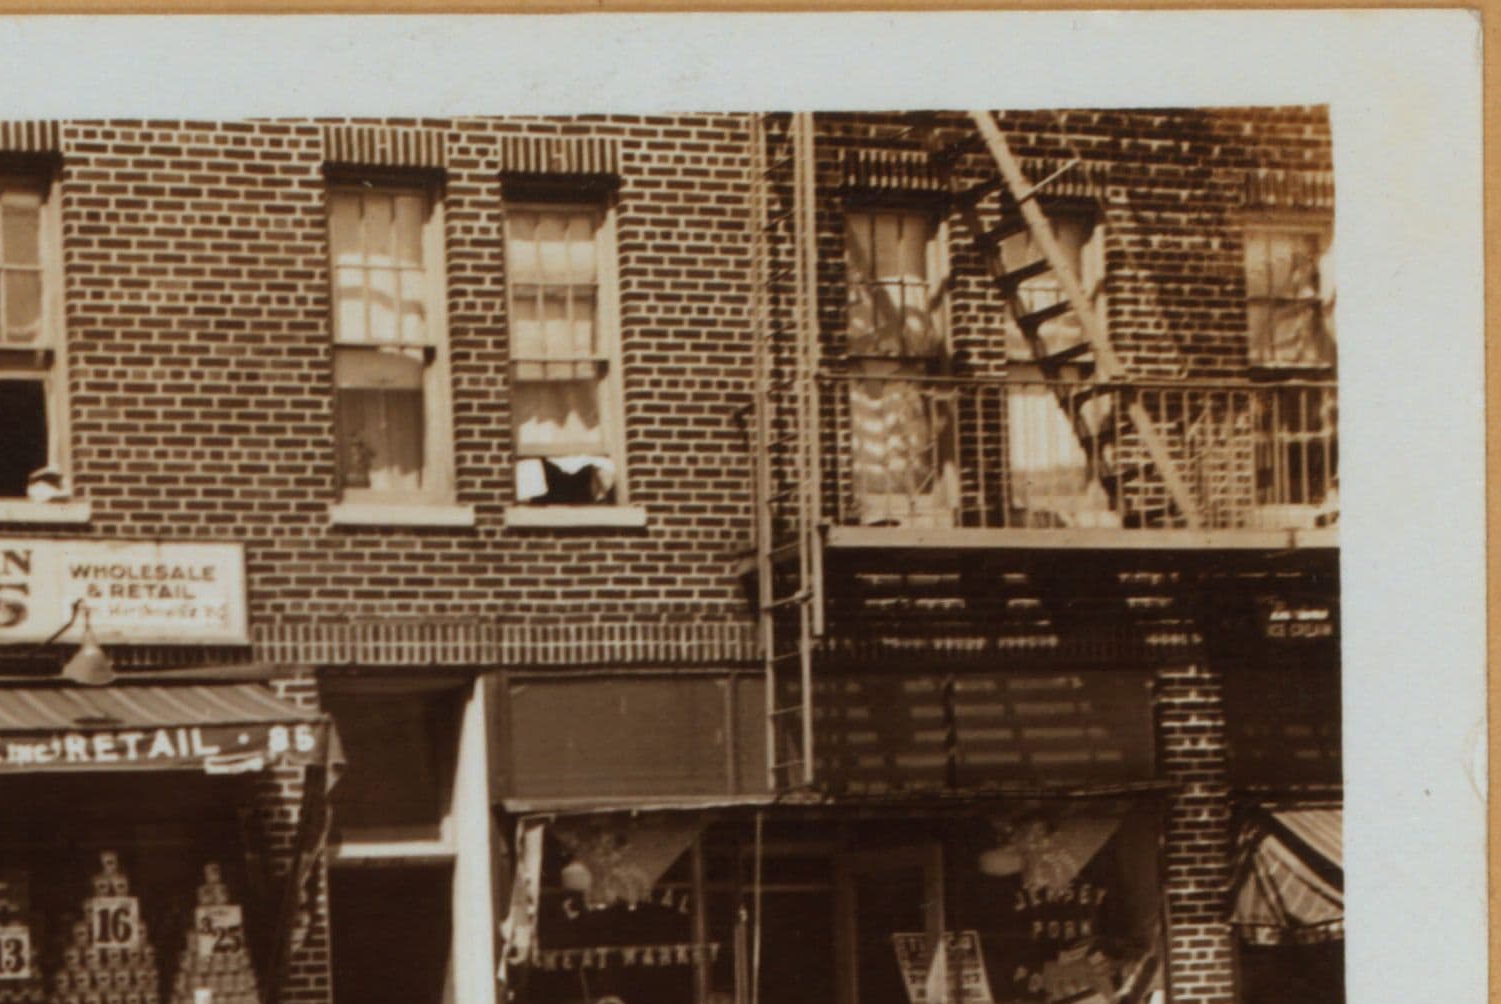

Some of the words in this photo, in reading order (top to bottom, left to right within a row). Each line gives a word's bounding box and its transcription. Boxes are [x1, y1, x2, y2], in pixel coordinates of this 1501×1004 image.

[69, 564, 217, 582] WHOLESALE
[86, 583, 102, 598] &
[109, 583, 197, 600] RETAIL
[63, 727, 221, 764] RETAIL
[96, 907, 133, 944] 16
[621, 941, 720, 967] MARKET
